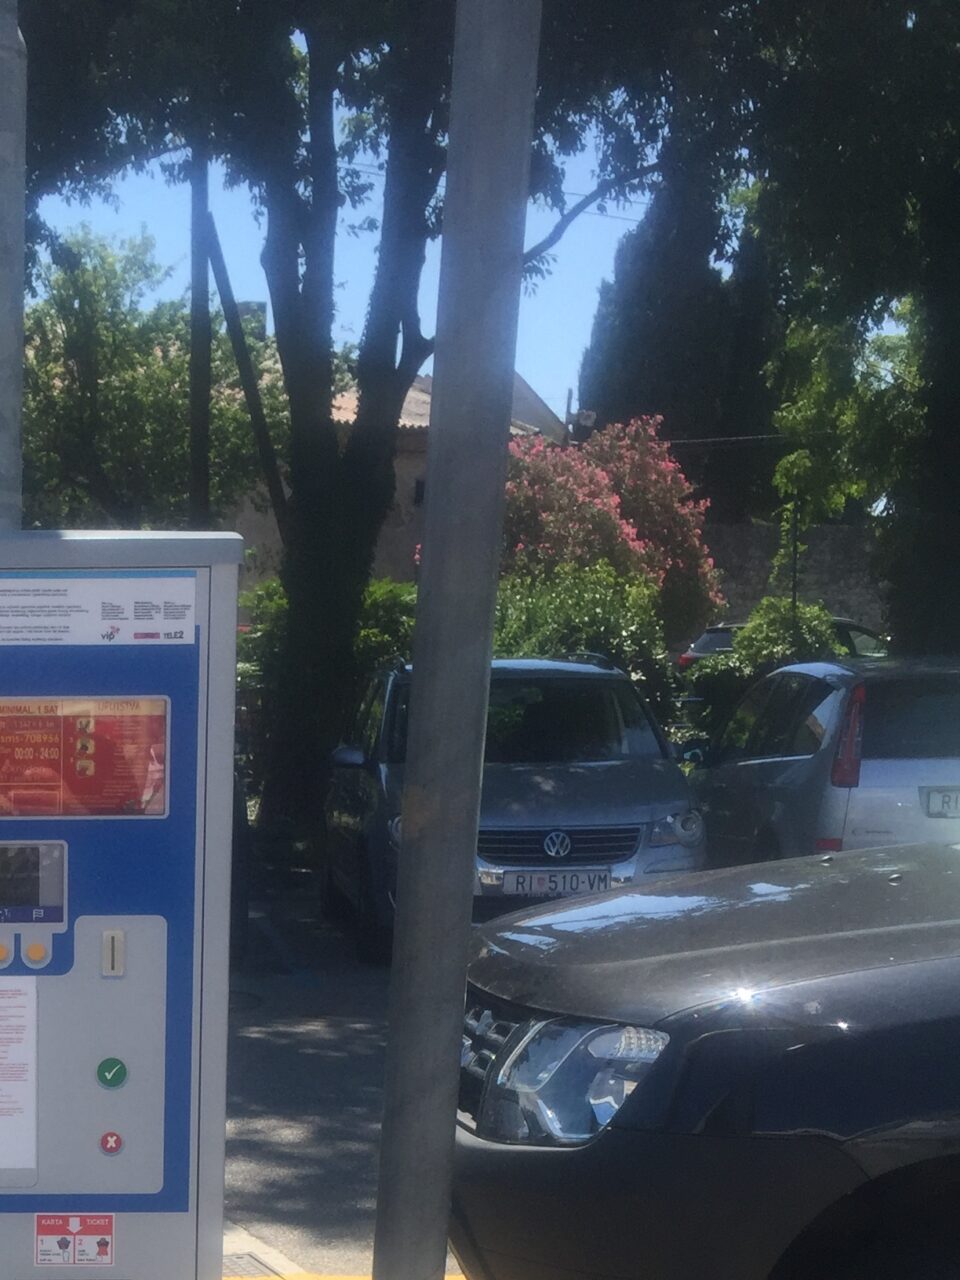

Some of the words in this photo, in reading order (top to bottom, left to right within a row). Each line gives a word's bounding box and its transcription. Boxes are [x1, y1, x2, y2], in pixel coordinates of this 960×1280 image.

[100, 631, 115, 642] vip
[163, 630, 184, 640] TELE2
[515, 874, 534, 892] RI
[548, 873, 608, 891] 510-VM
